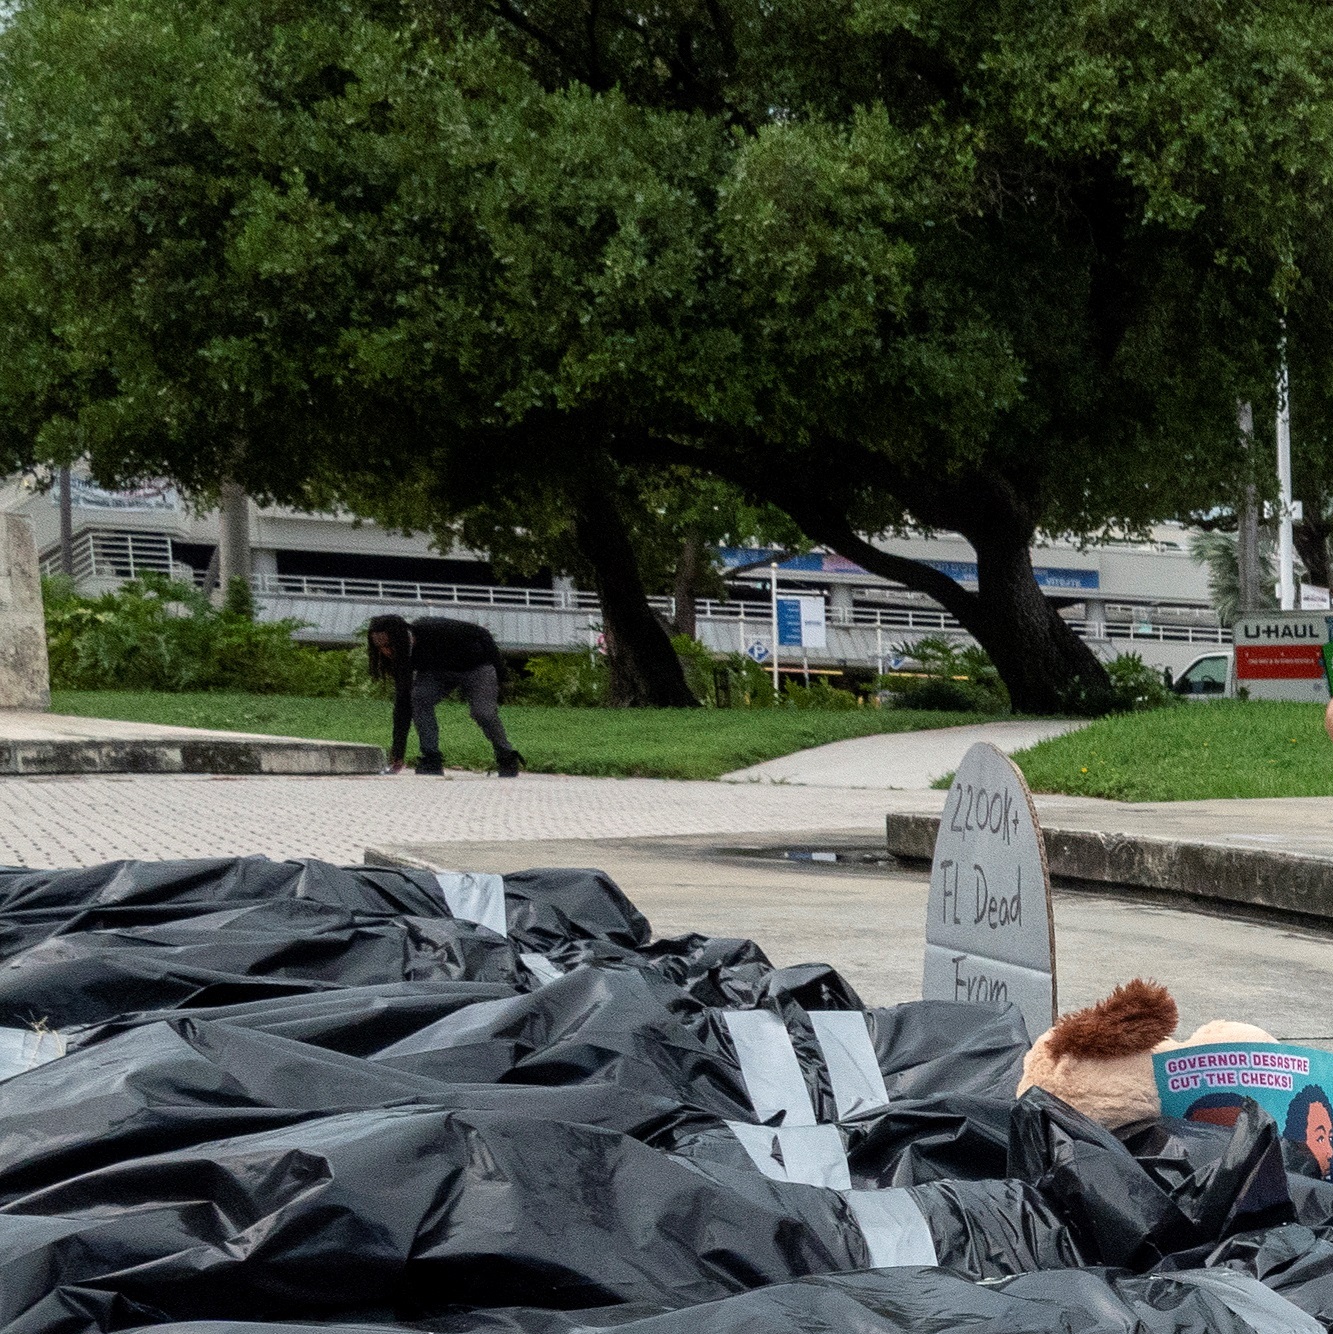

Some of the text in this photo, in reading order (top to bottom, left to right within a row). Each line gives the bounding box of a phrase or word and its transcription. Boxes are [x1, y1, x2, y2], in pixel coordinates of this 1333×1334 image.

[1244, 624, 1320, 639] U-HAUL
[940, 860, 1022, 930] FL Dead
[952, 955, 1008, 1001] From
[1167, 1053, 1308, 1073] GOVERNOR DESASTRE
[1170, 1072, 1292, 1090] CUT THE CHECKS!
